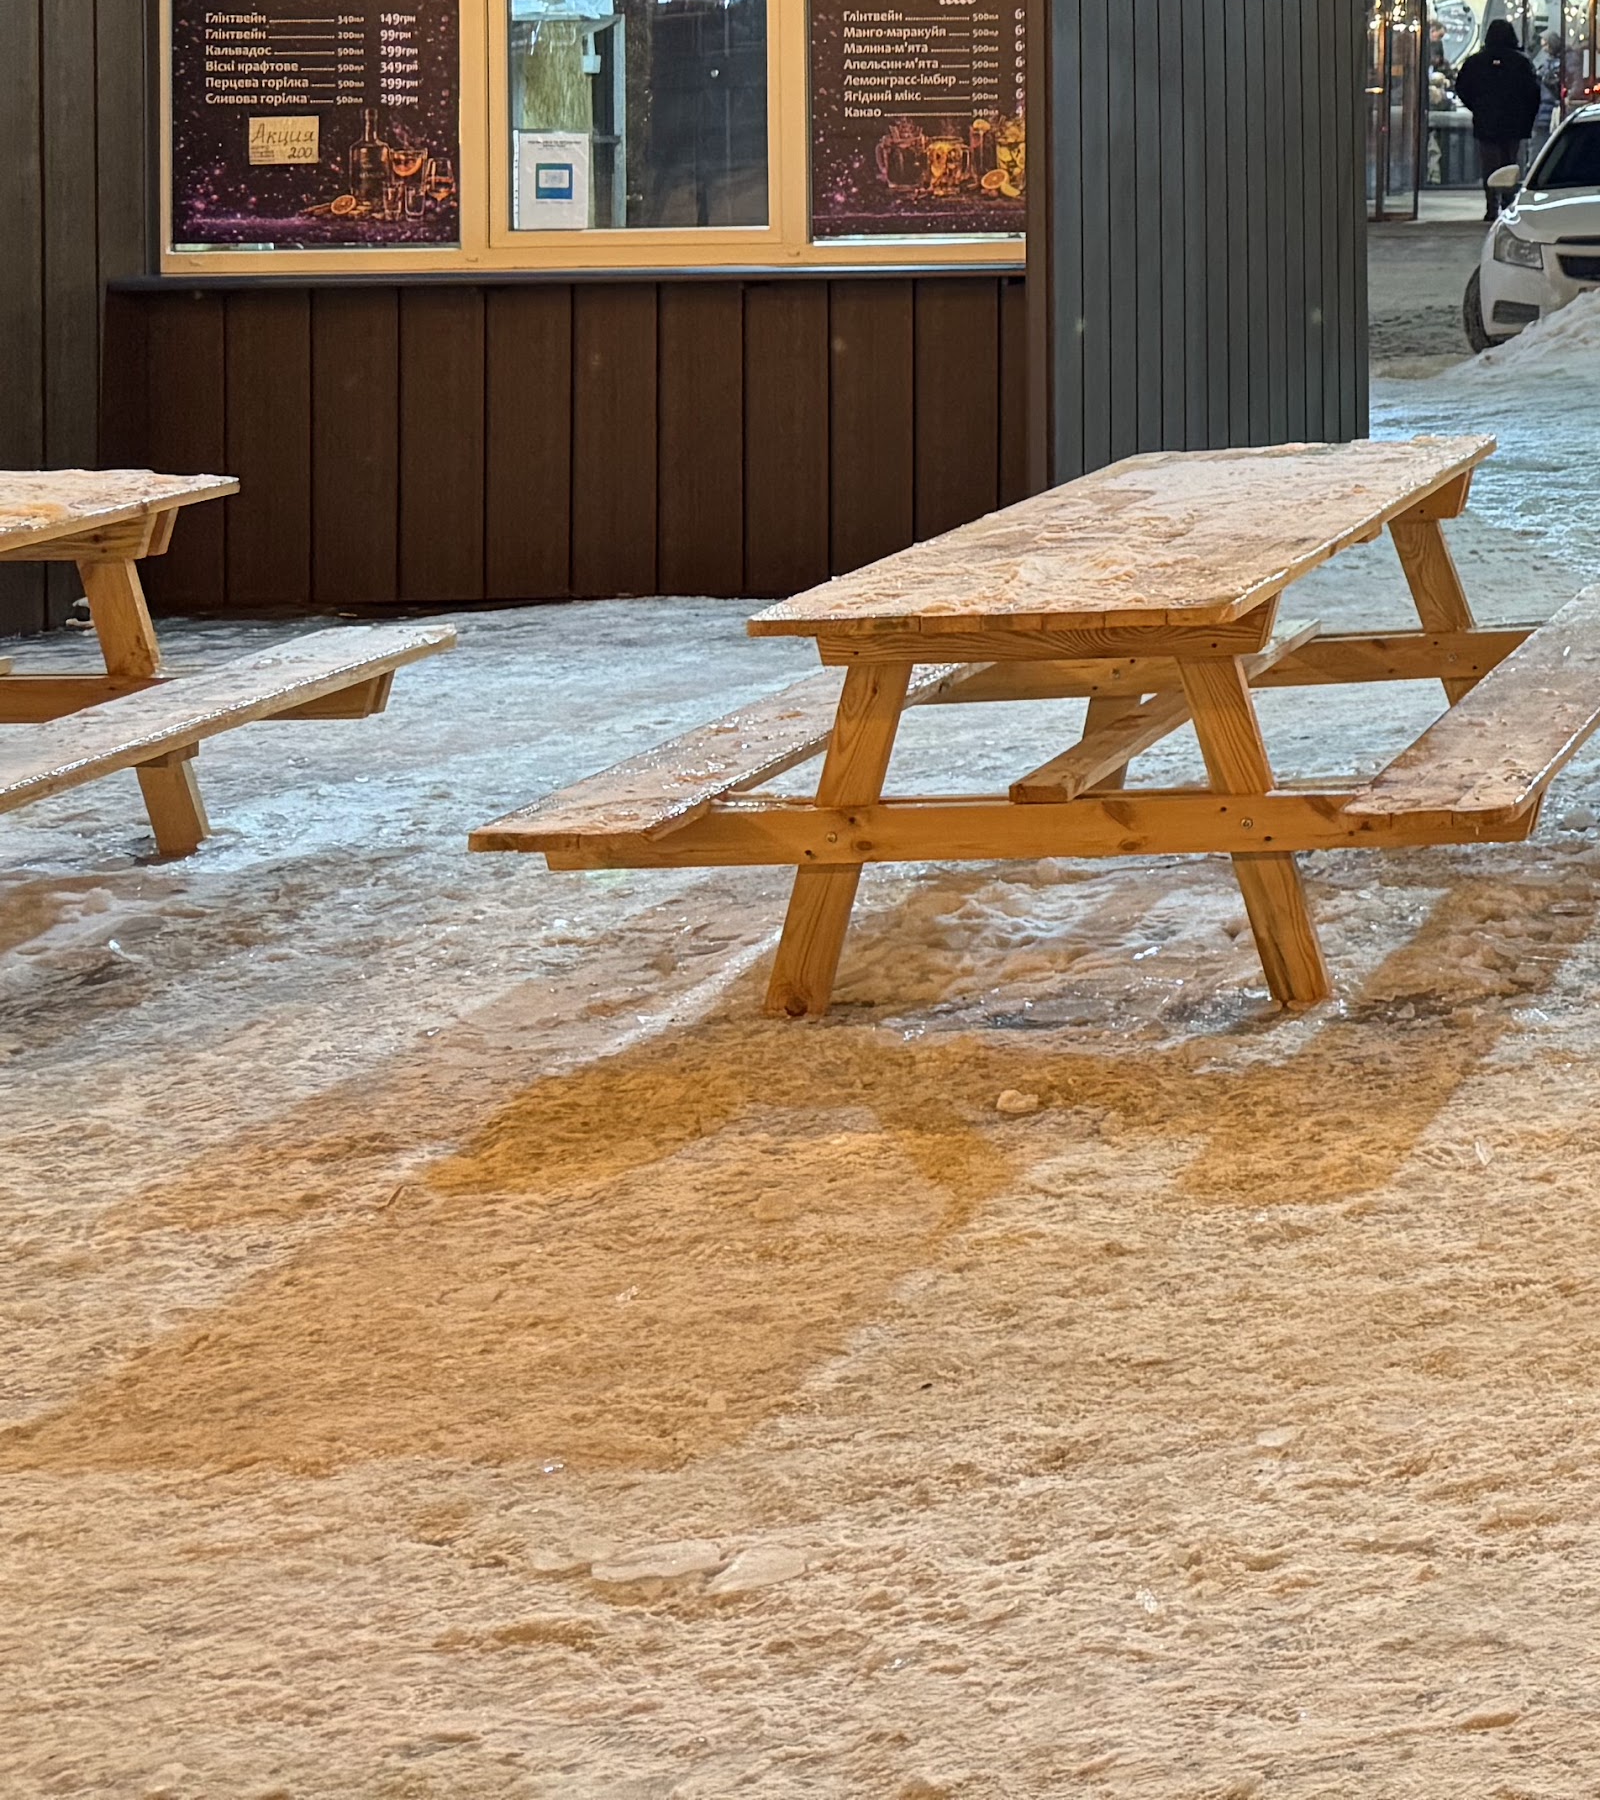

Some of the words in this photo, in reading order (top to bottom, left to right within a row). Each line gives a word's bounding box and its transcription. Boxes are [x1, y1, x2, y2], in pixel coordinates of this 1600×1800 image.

[204, 12, 267, 24] Глінтвейн
[843, 10, 903, 22] Глінтвейн
[204, 29, 267, 41] Глінтвейн
[379, 29, 412, 41] 99грн
[204, 45, 272, 58] Кальвадос
[380, 45, 419, 57] 299грн
[204, 60, 236, 72] Віскі
[237, 60, 299, 74] крафтове
[204, 77, 260, 90] Перцева
[261, 76, 309, 90] горілка
[380, 77, 419, 90] 299грн
[204, 93, 259, 105] Сливова
[260, 92, 308, 106] горілка
[380, 93, 419, 106] 299грн
[843, 90, 892, 103] Ягідний
[894, 90, 921, 101] мікс
[844, 107, 882, 117] Какао
[287, 146, 313, 159] 200
